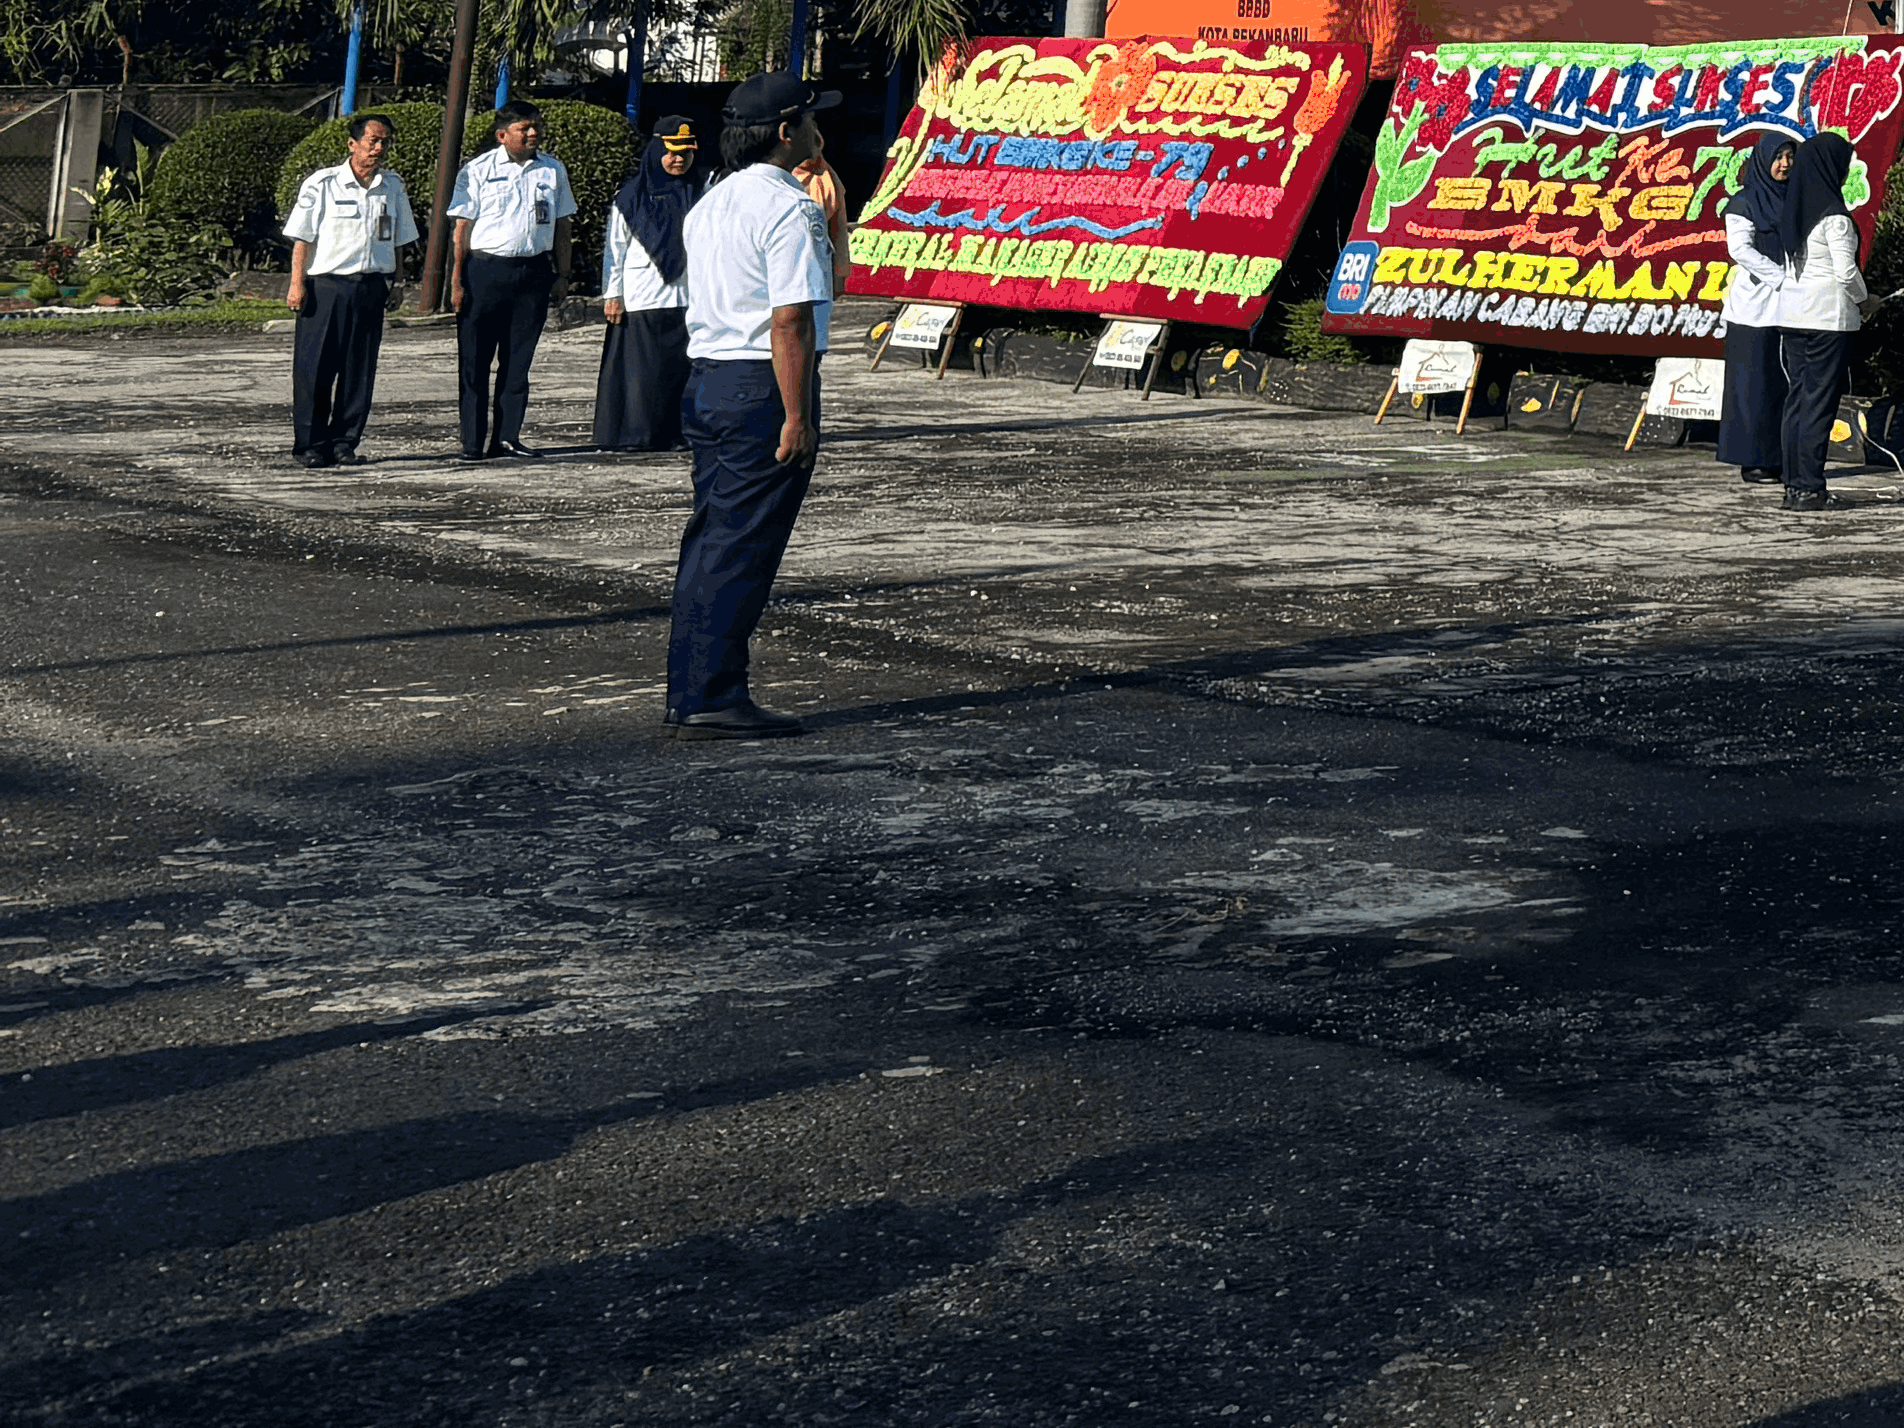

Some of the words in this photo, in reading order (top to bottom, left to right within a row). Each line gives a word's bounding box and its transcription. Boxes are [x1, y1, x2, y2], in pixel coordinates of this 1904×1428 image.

[1197, 25, 1228, 41] KOTA
[1470, 58, 1655, 126] SELAMAT
[1646, 56, 1806, 116] SUKSES
[927, 134, 1000, 166] HUT
[1426, 176, 1694, 232] BMKG
[1337, 253, 1371, 282] BRI
[1372, 245, 1702, 301] ZULHERMAN
